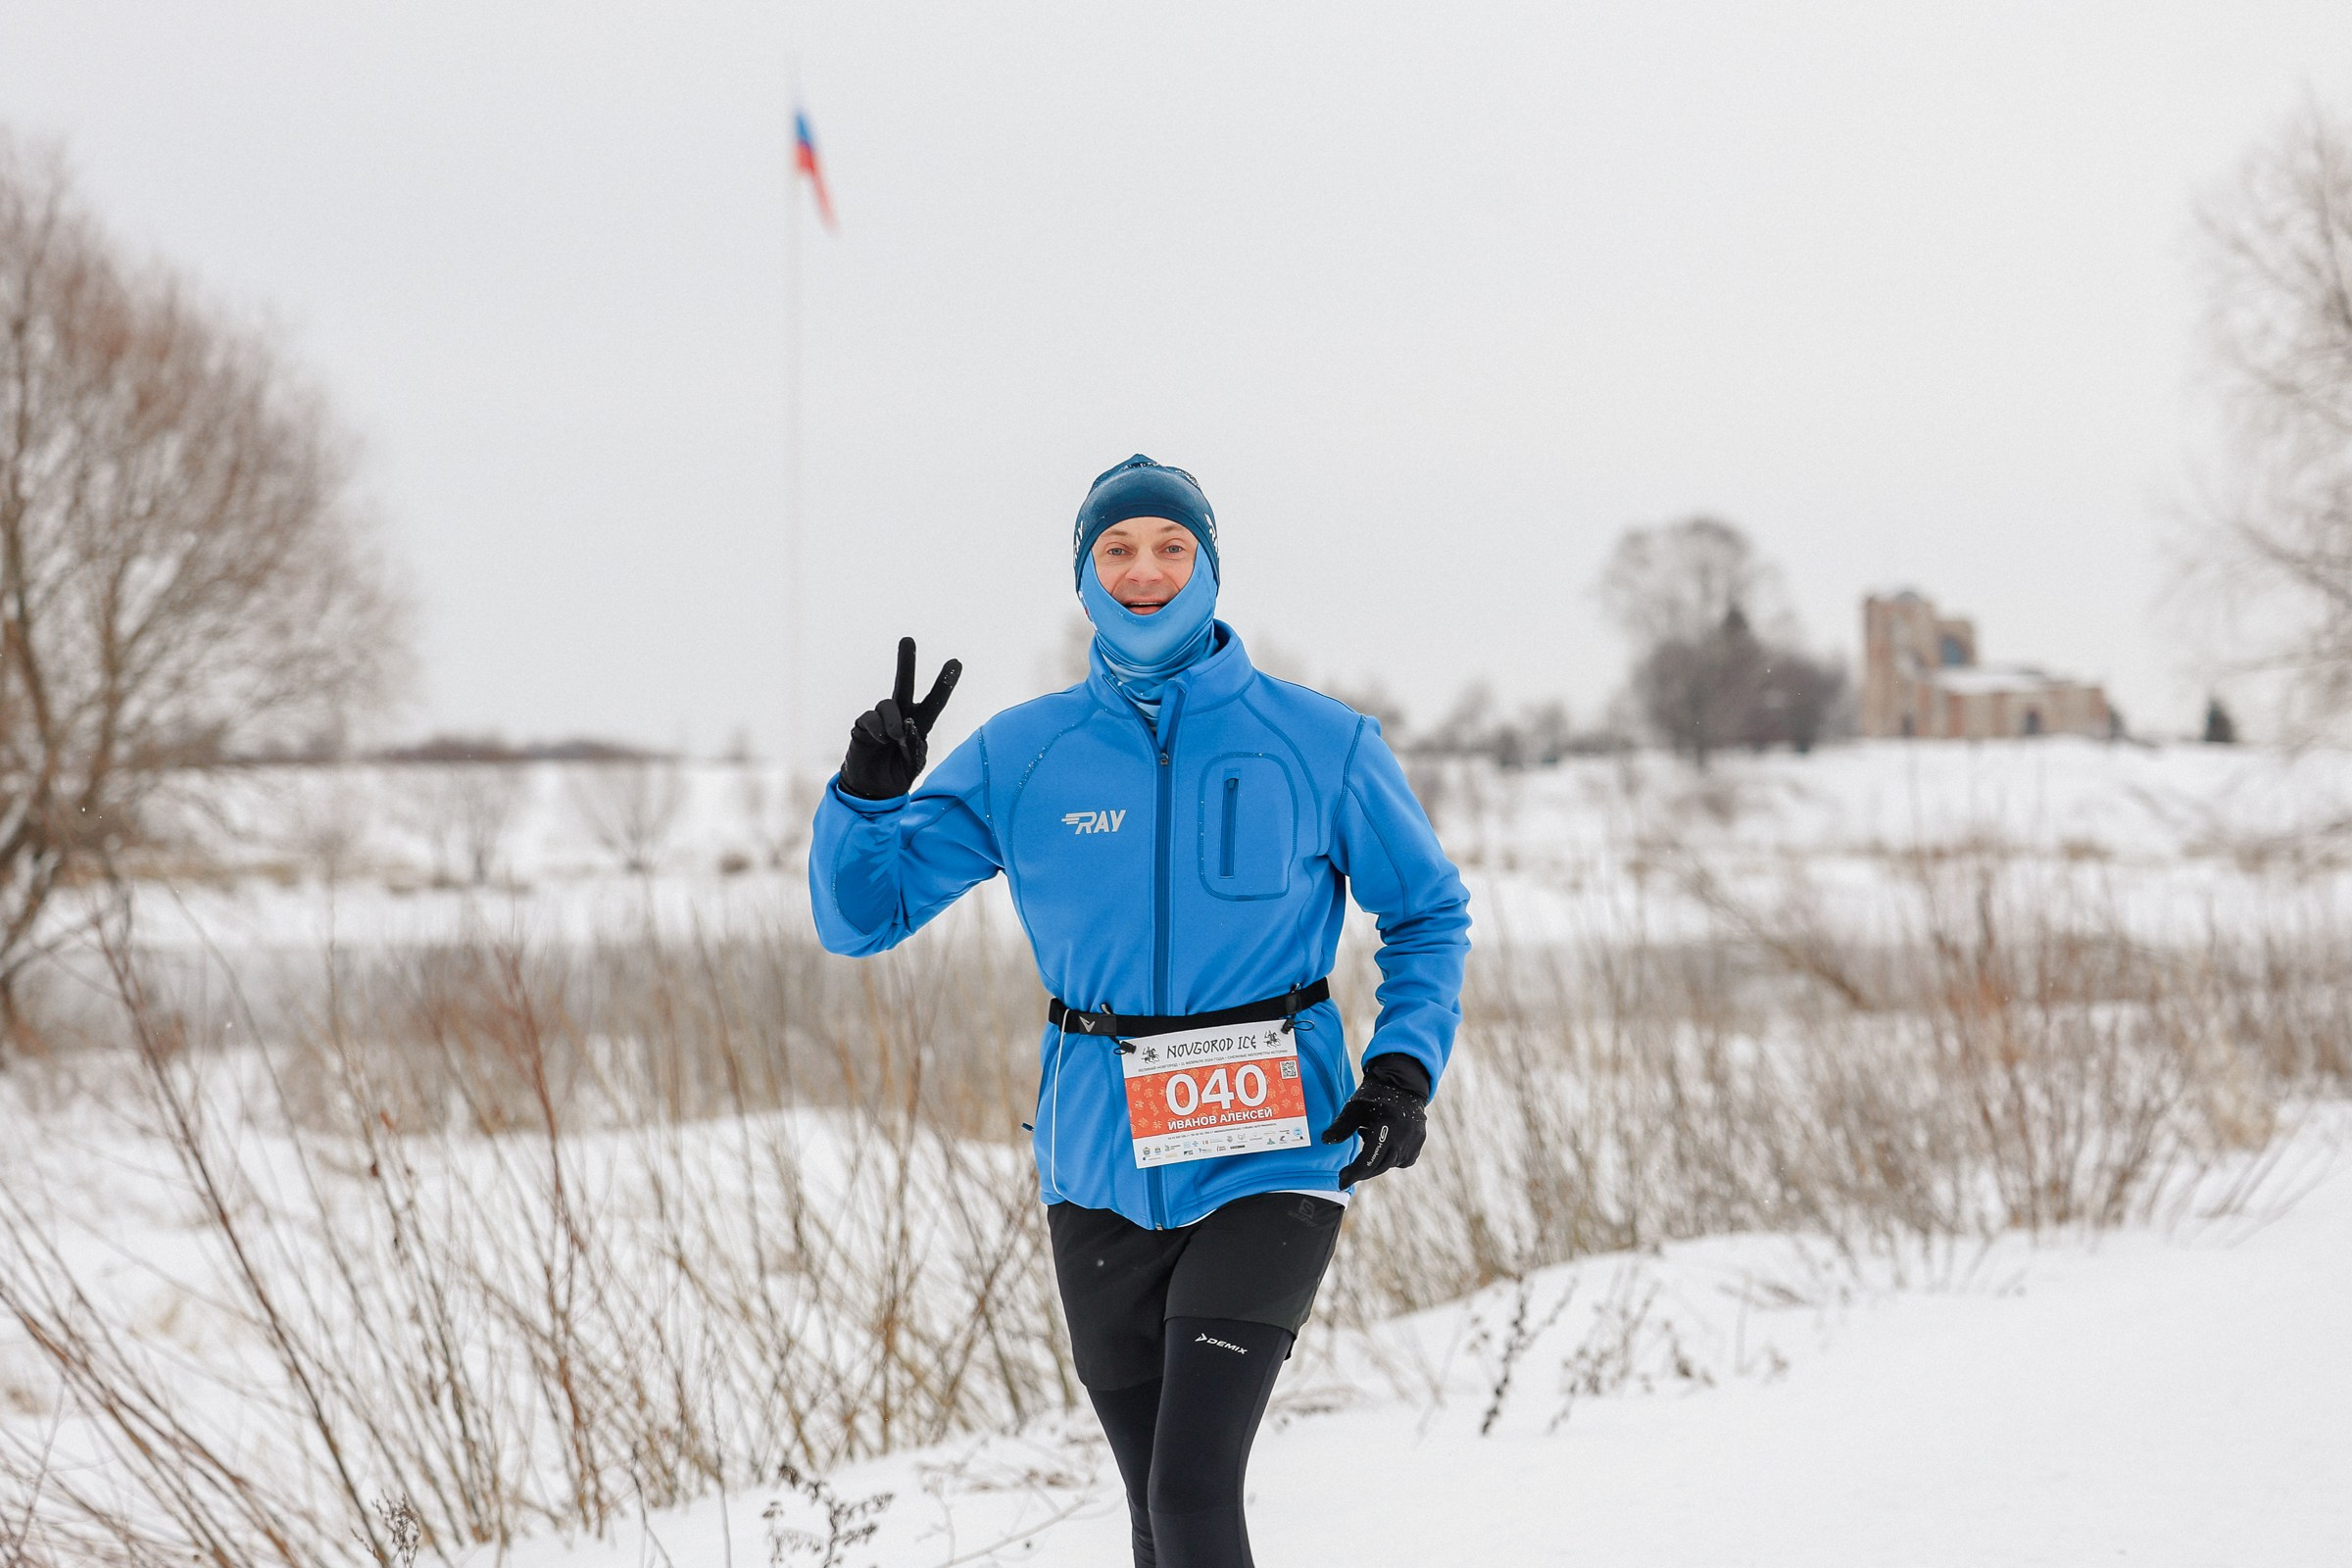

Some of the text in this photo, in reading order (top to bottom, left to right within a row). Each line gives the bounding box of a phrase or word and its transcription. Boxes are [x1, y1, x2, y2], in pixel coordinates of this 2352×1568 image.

[1061, 809, 1126, 835] RAY
[1166, 1035, 1257, 1059] NOVGOROD ICE
[1165, 1063, 1268, 1116] 040
[1167, 1106, 1273, 1131] ИВАНОВ АЛЕКСЕЙ
[1206, 1338, 1249, 1354] DEMIX
